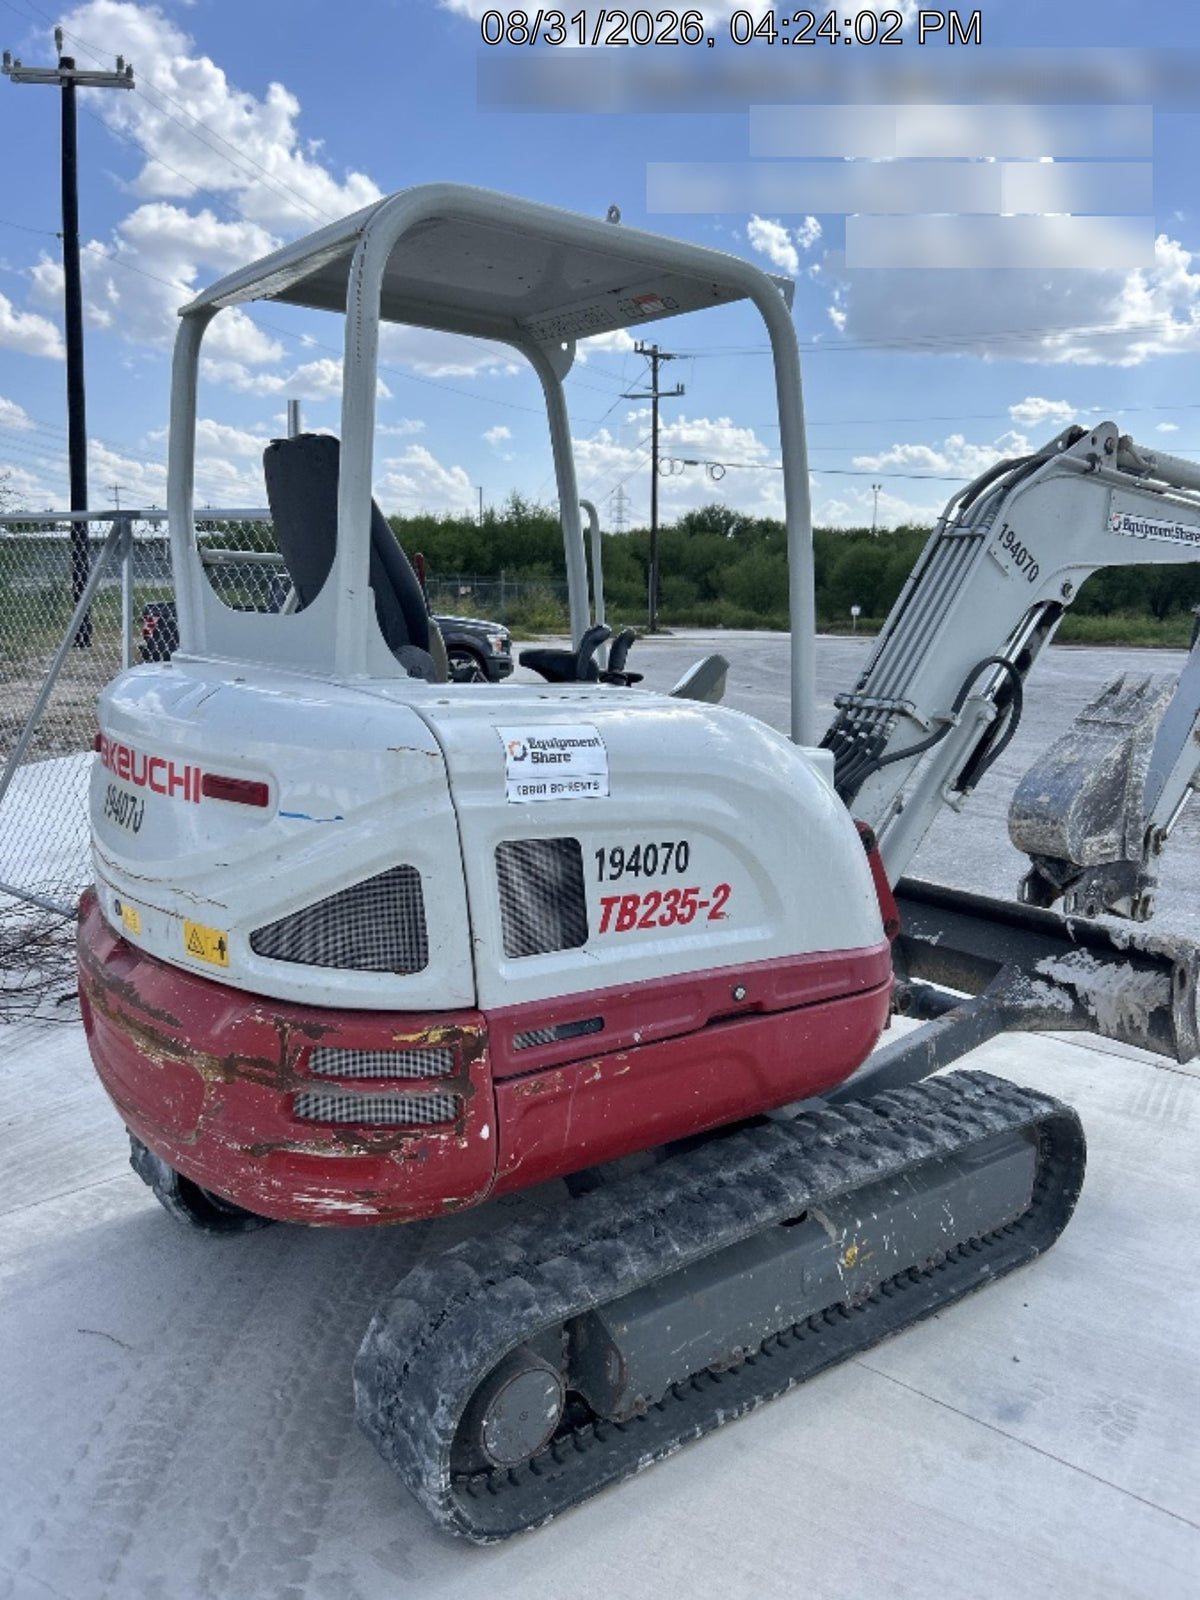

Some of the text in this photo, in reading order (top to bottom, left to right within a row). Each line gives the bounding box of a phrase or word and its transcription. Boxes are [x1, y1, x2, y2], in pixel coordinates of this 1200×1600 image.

[997, 523, 1040, 584] 194070
[526, 736, 601, 751] Equipment
[530, 751, 572, 764] Share
[99, 734, 202, 804] AKEUCHI
[595, 840, 690, 882] 194070
[598, 883, 732, 934] TB235-2
